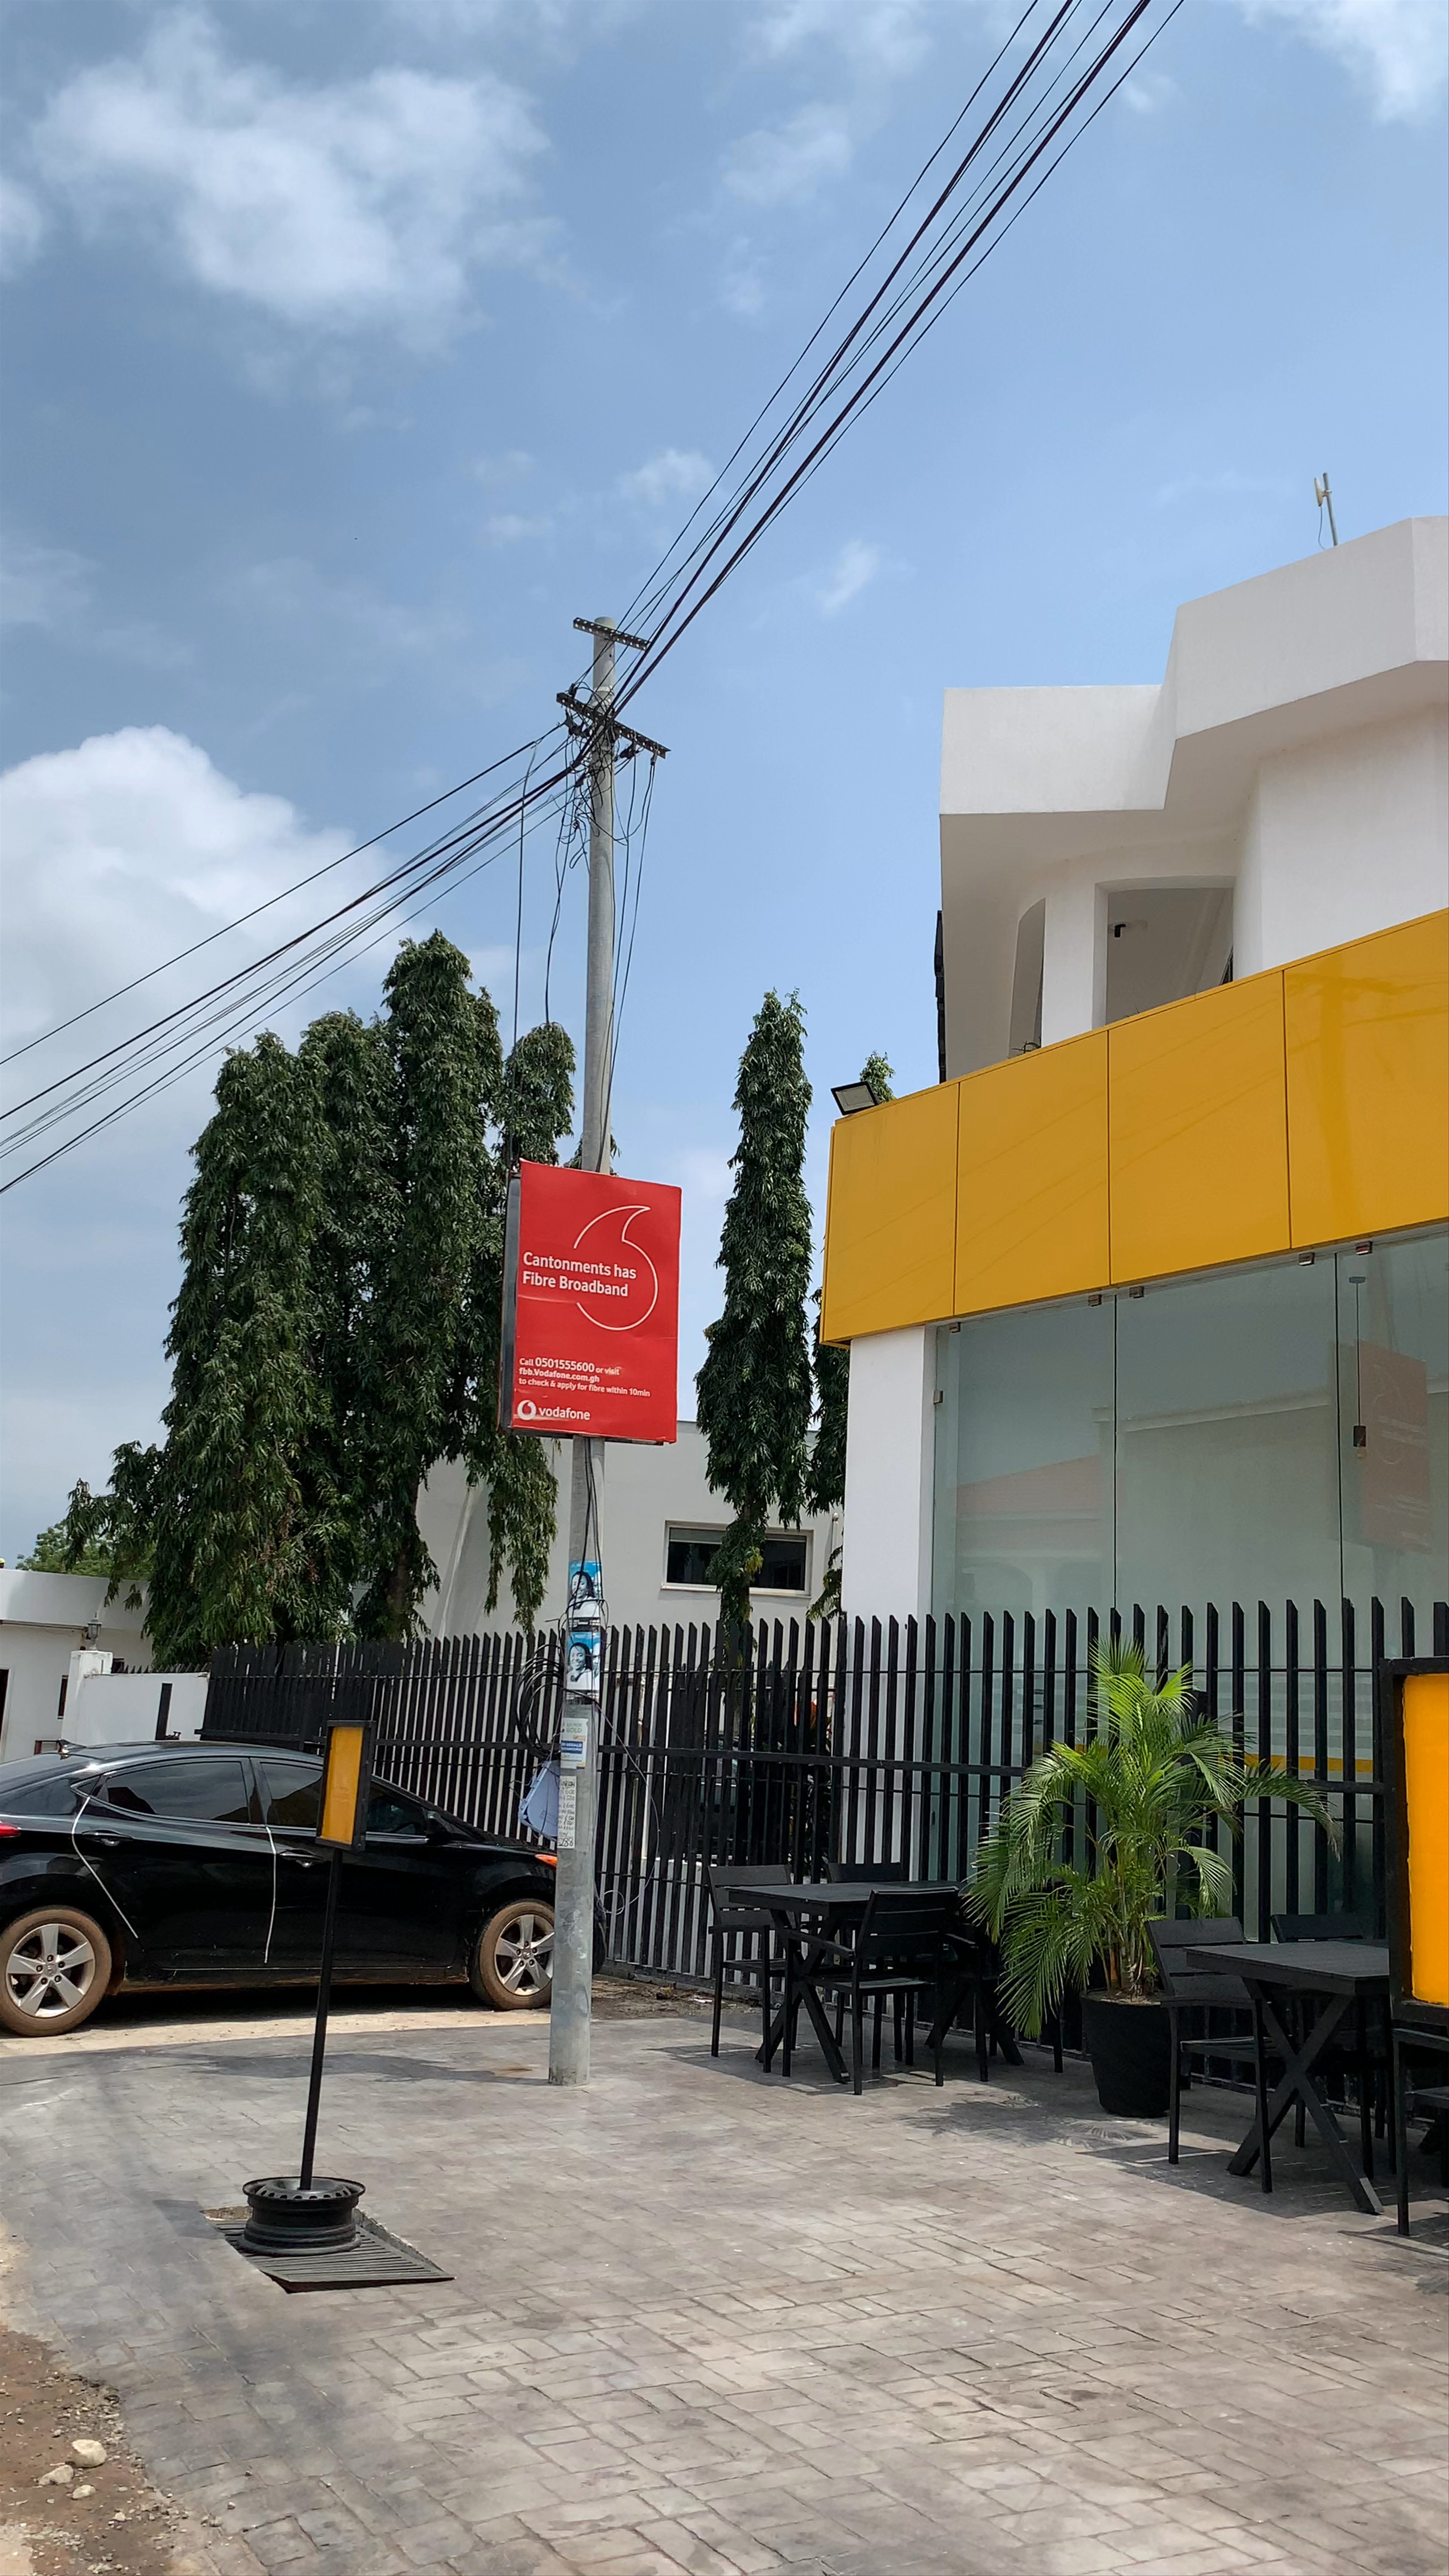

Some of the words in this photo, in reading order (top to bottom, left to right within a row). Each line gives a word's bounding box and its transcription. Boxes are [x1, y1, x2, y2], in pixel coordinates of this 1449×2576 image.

[523, 1252, 611, 1276] Cantonments
[614, 1264, 637, 1279] has
[523, 1270, 556, 1287] Fibre
[560, 1275, 628, 1296] Broadband
[535, 1357, 595, 1372] 0501555600
[519, 1367, 600, 1383] fbb.Vodafone.com.gh
[528, 1378, 549, 1387] check
[557, 1382, 576, 1390] apply
[606, 1386, 628, 1394] within
[629, 1388, 651, 1396] 10min
[538, 1407, 591, 1420] vodafone
